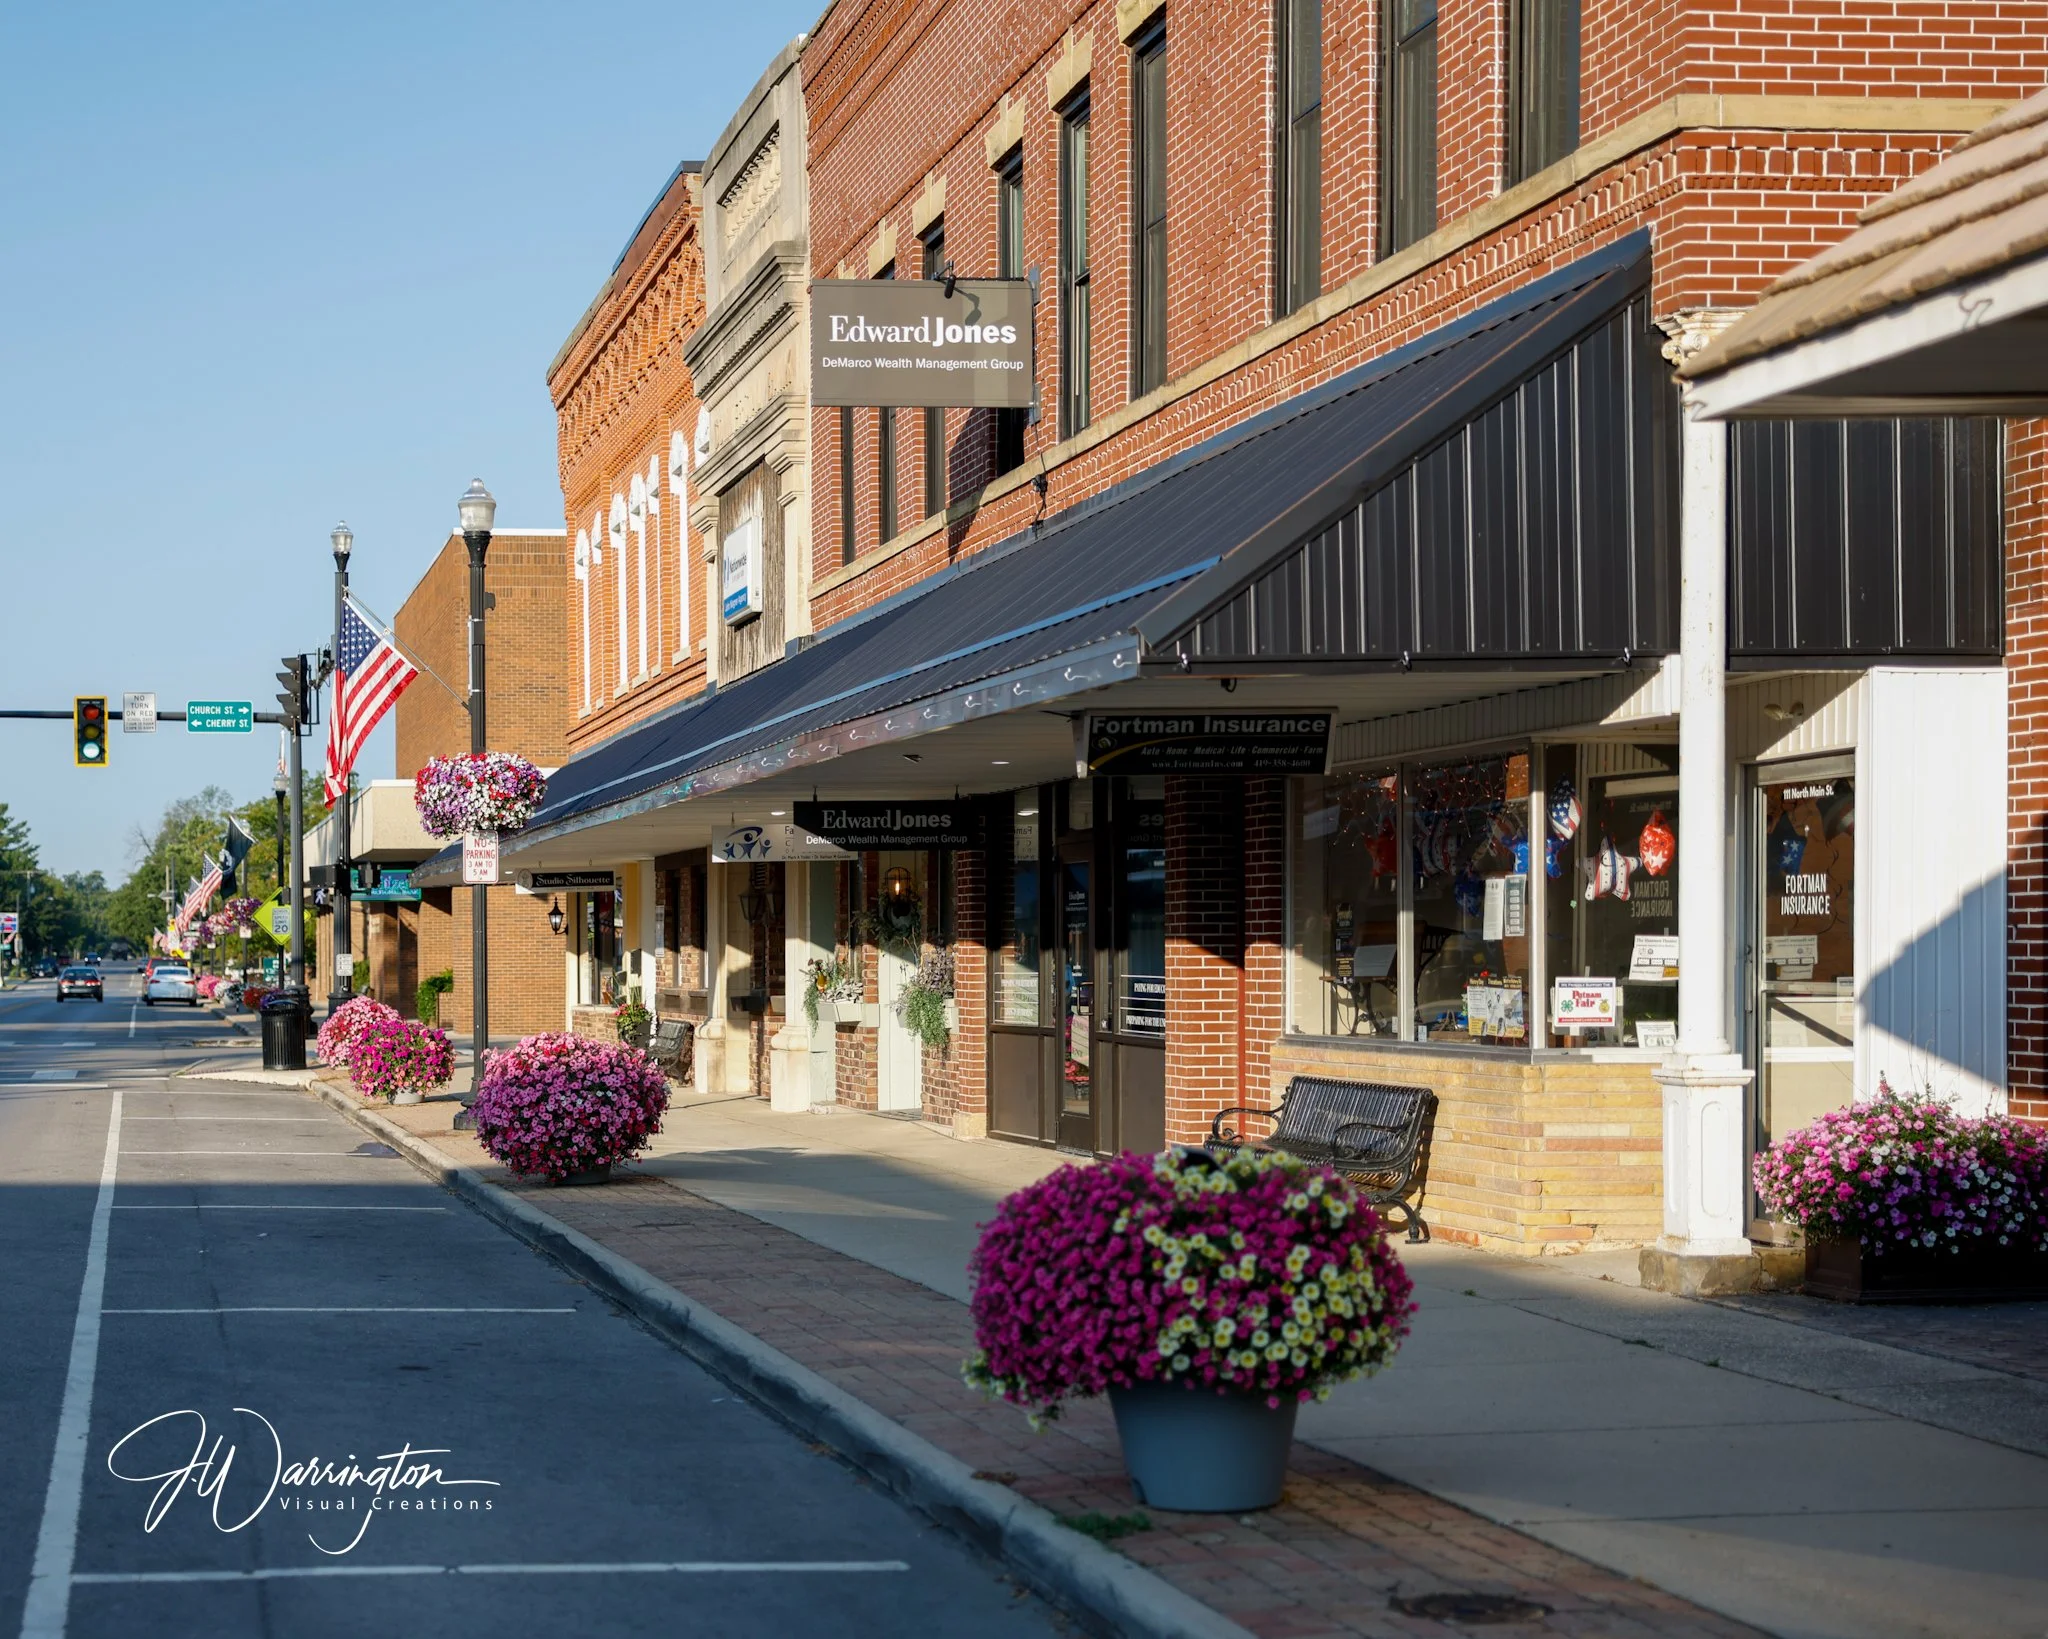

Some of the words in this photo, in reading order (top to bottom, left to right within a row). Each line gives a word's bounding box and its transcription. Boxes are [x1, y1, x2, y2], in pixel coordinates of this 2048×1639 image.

[829, 315, 931, 343] Edward
[932, 316, 1017, 347] Jones
[822, 357, 872, 369] DeMarco
[874, 357, 912, 369] Wealth
[915, 358, 988, 371] Management
[990, 358, 1024, 371] Group
[190, 706, 221, 715] CHURCH
[224, 706, 235, 715] ST.
[206, 719, 236, 728] CHERRY
[239, 719, 249, 728] ST.
[1091, 716, 1195, 734] Fortman
[1203, 715, 1327, 734] Insurance
[1140, 746, 1160, 756] Auto
[1166, 746, 1189, 756] Home
[1193, 745, 1225, 755] Medical
[1230, 745, 1246, 755] Life
[1251, 745, 1299, 755] Commercial
[1303, 745, 1323, 755] Farm
[1791, 786, 1809, 799] North
[1809, 785, 1825, 798] Main
[1825, 784, 1834, 796] St.
[821, 809, 891, 829] Edward
[893, 809, 952, 831] Jones
[474, 838, 487, 848] NO
[806, 835, 847, 845] DeMarco
[848, 834, 879, 845] Wealth
[880, 834, 939, 846] Management
[940, 834, 968, 846] Group
[466, 850, 496, 859] PARKING
[536, 874, 565, 887] Studio
[565, 873, 610, 886] Silhouette
[1785, 873, 1827, 894] FORTMAN
[1781, 894, 1831, 916] INSURANCE
[274, 924, 288, 933] 20
[1572, 990, 1602, 999] Putnam
[1576, 999, 1595, 1008] Fair
